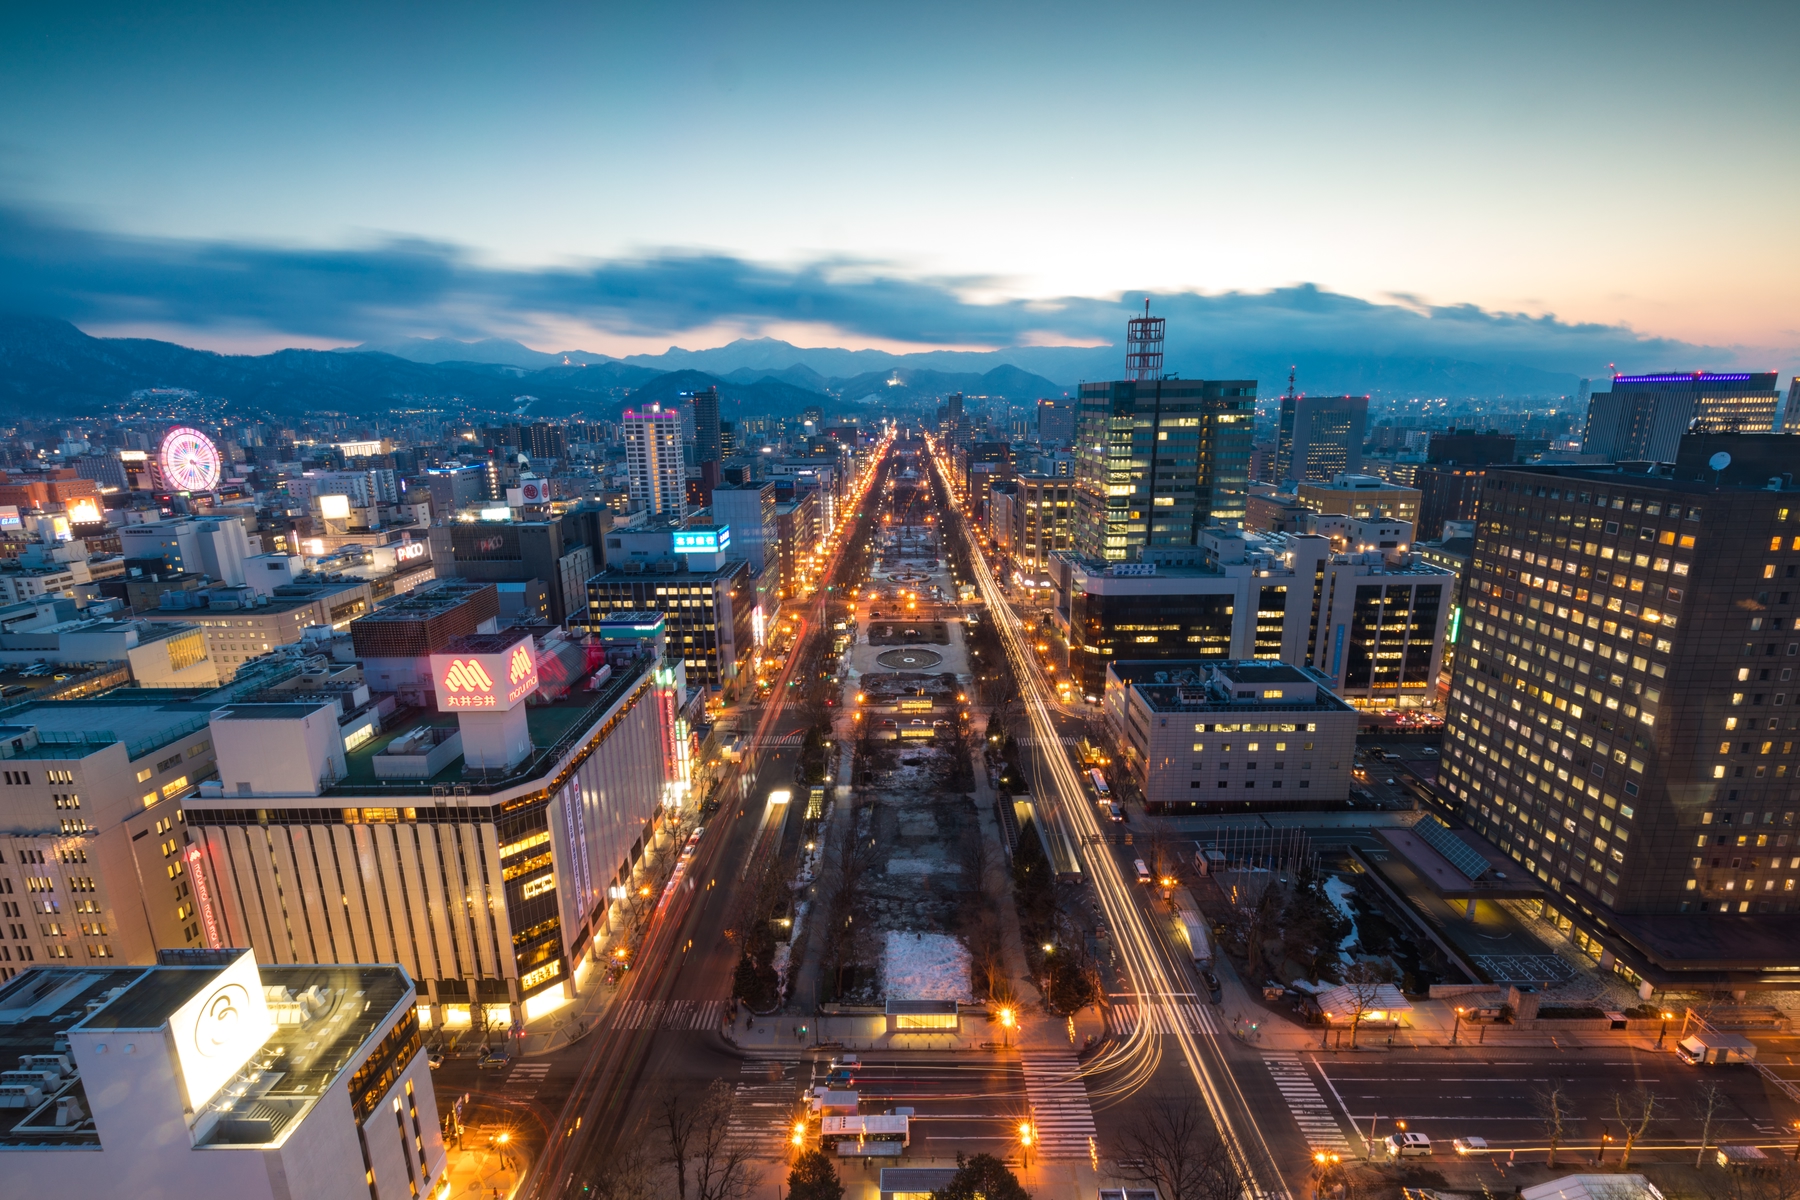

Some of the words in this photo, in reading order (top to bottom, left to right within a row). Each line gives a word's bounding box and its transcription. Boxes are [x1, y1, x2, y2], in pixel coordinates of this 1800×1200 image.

[397, 543, 423, 561] PARCO
[447, 695, 496, 707] 丸井今井
